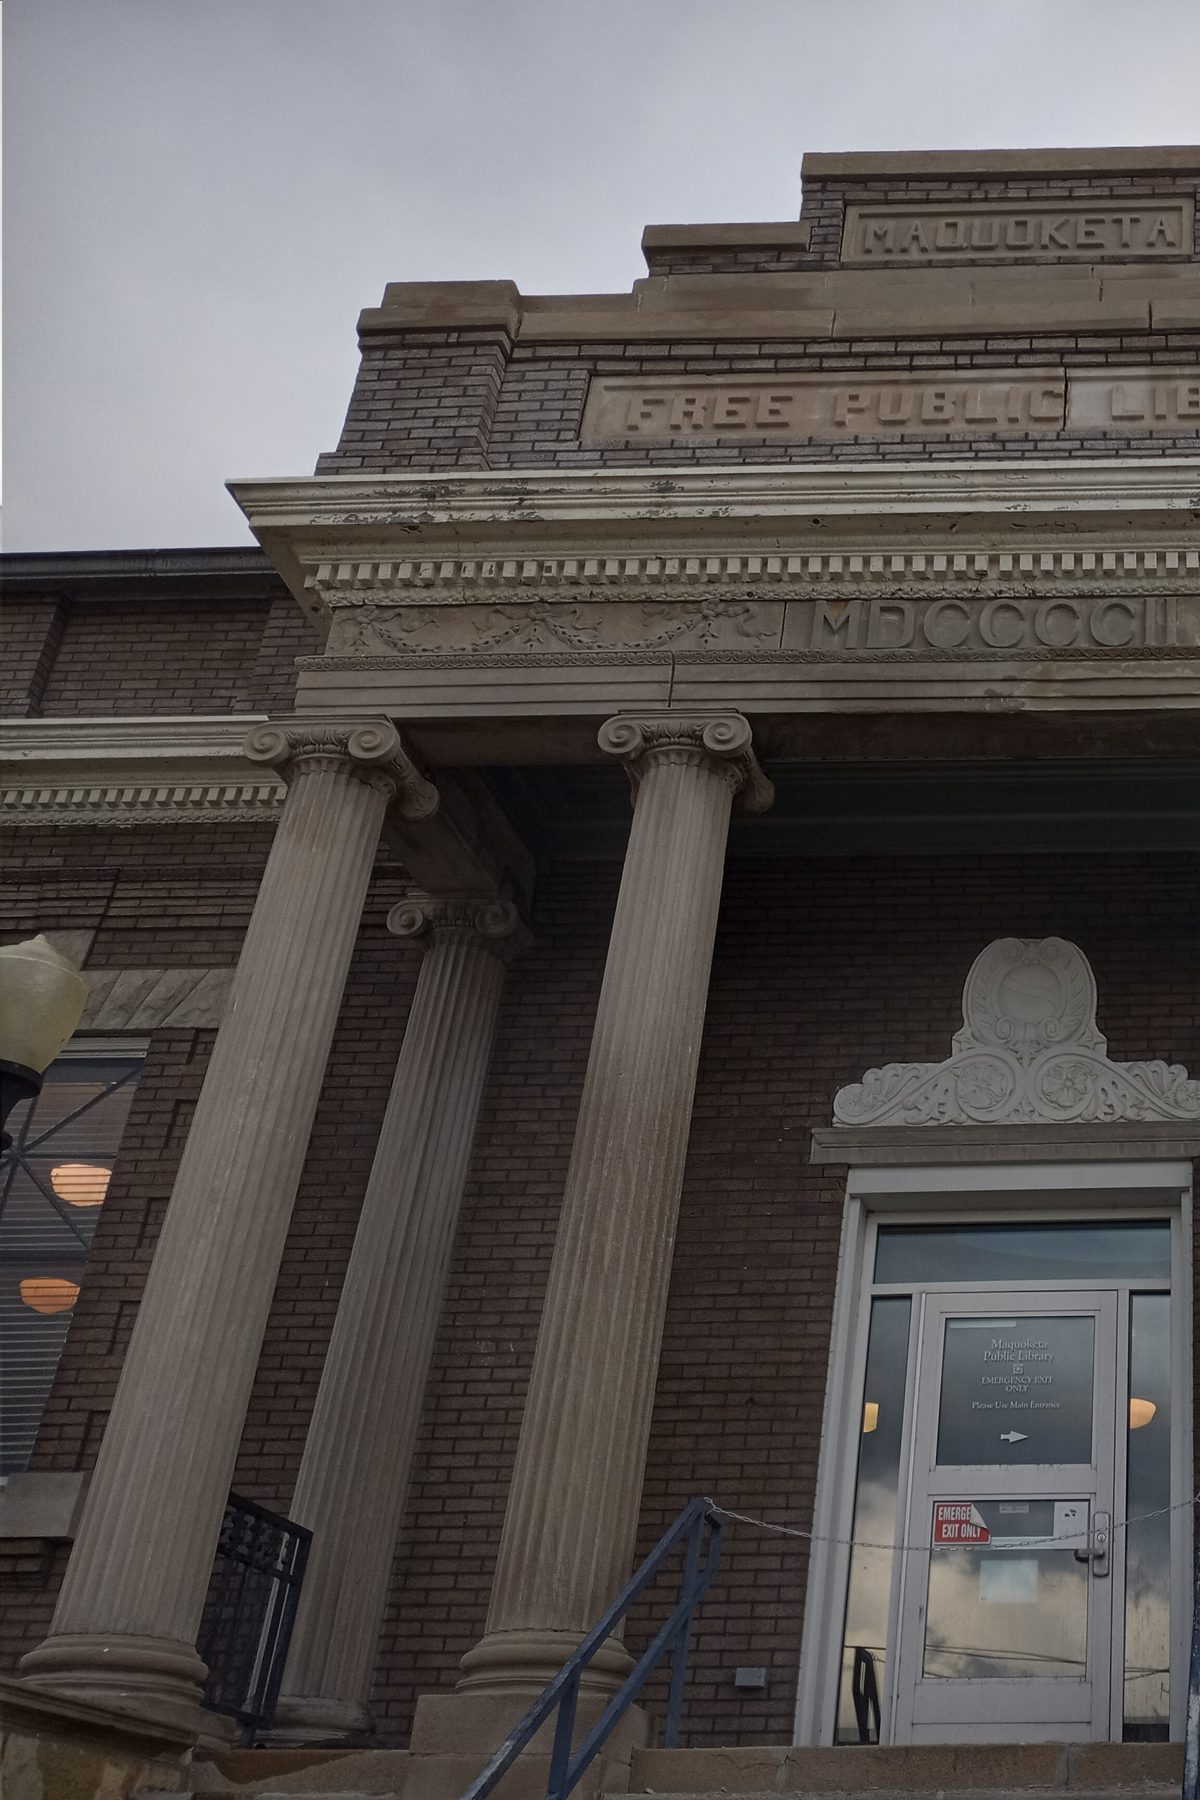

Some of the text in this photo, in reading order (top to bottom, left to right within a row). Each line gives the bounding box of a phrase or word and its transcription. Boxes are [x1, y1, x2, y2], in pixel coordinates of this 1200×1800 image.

[864, 215, 1177, 254] MAQUOKETA
[626, 396, 794, 431] FREE
[834, 385, 1064, 427] PUBLIC
[810, 597, 1178, 650] MDCCCCII
[991, 1338, 1048, 1352] Maquoketa
[984, 1350, 1054, 1363] Public Library
[981, 1376, 1053, 1385] EMERGENCY EXIT
[1005, 1384, 1029, 1393] ONLY
[972, 1401, 1061, 1410] Please Use Main Entrance
[942, 1523, 959, 1538] EXIT
